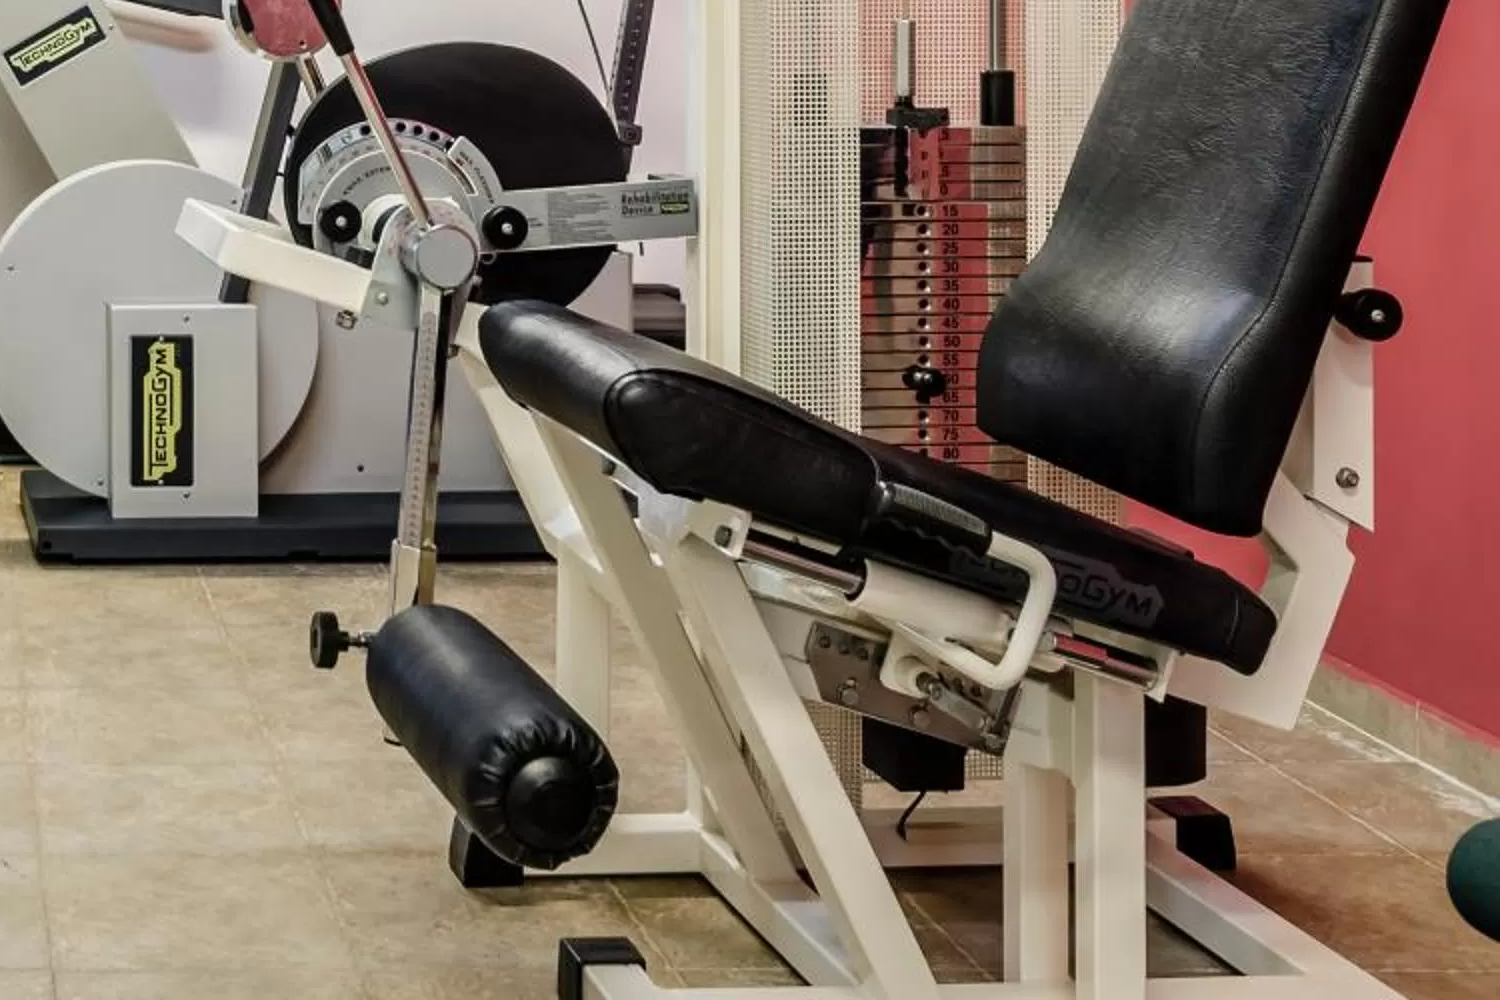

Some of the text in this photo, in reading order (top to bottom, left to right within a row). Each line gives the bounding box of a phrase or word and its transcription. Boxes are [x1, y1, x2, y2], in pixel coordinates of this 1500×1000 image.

[942, 205, 959, 216] 15
[943, 223, 960, 236] 20
[943, 242, 960, 254] 25
[943, 260, 960, 272] 30
[943, 279, 960, 291] 35
[943, 298, 960, 310] 40
[943, 317, 960, 329] 45
[943, 335, 960, 347] 50
[943, 354, 960, 366] 55
[943, 409, 960, 422] 70
[943, 428, 960, 440] 75
